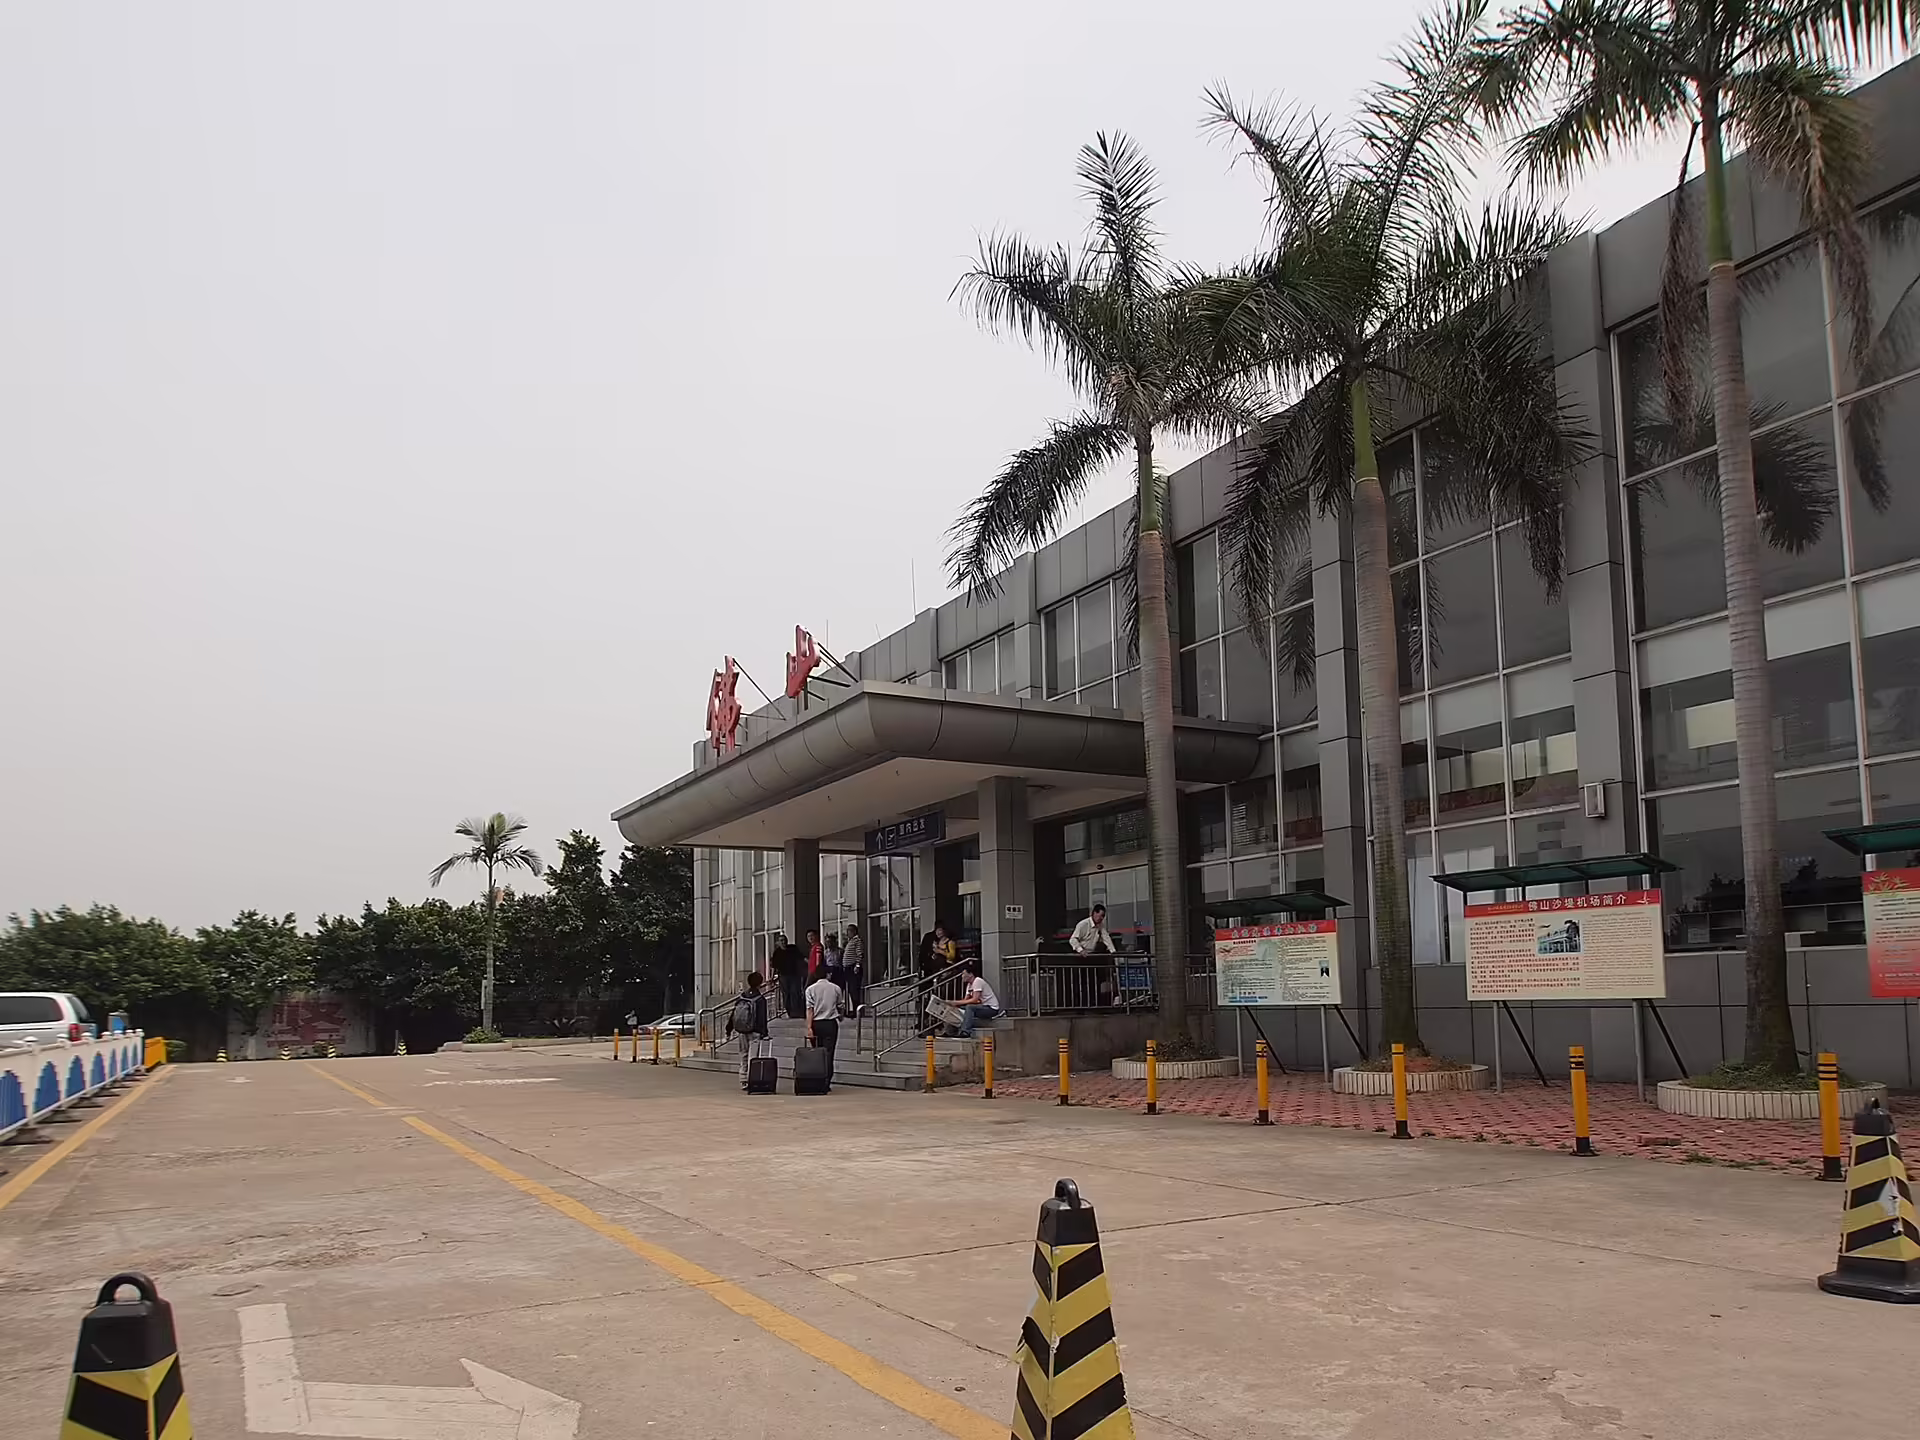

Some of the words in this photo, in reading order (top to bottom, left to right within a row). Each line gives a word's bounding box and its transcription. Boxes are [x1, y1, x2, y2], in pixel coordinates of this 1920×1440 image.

[1528, 894, 1626, 911] 佛山沙堤机场简介
